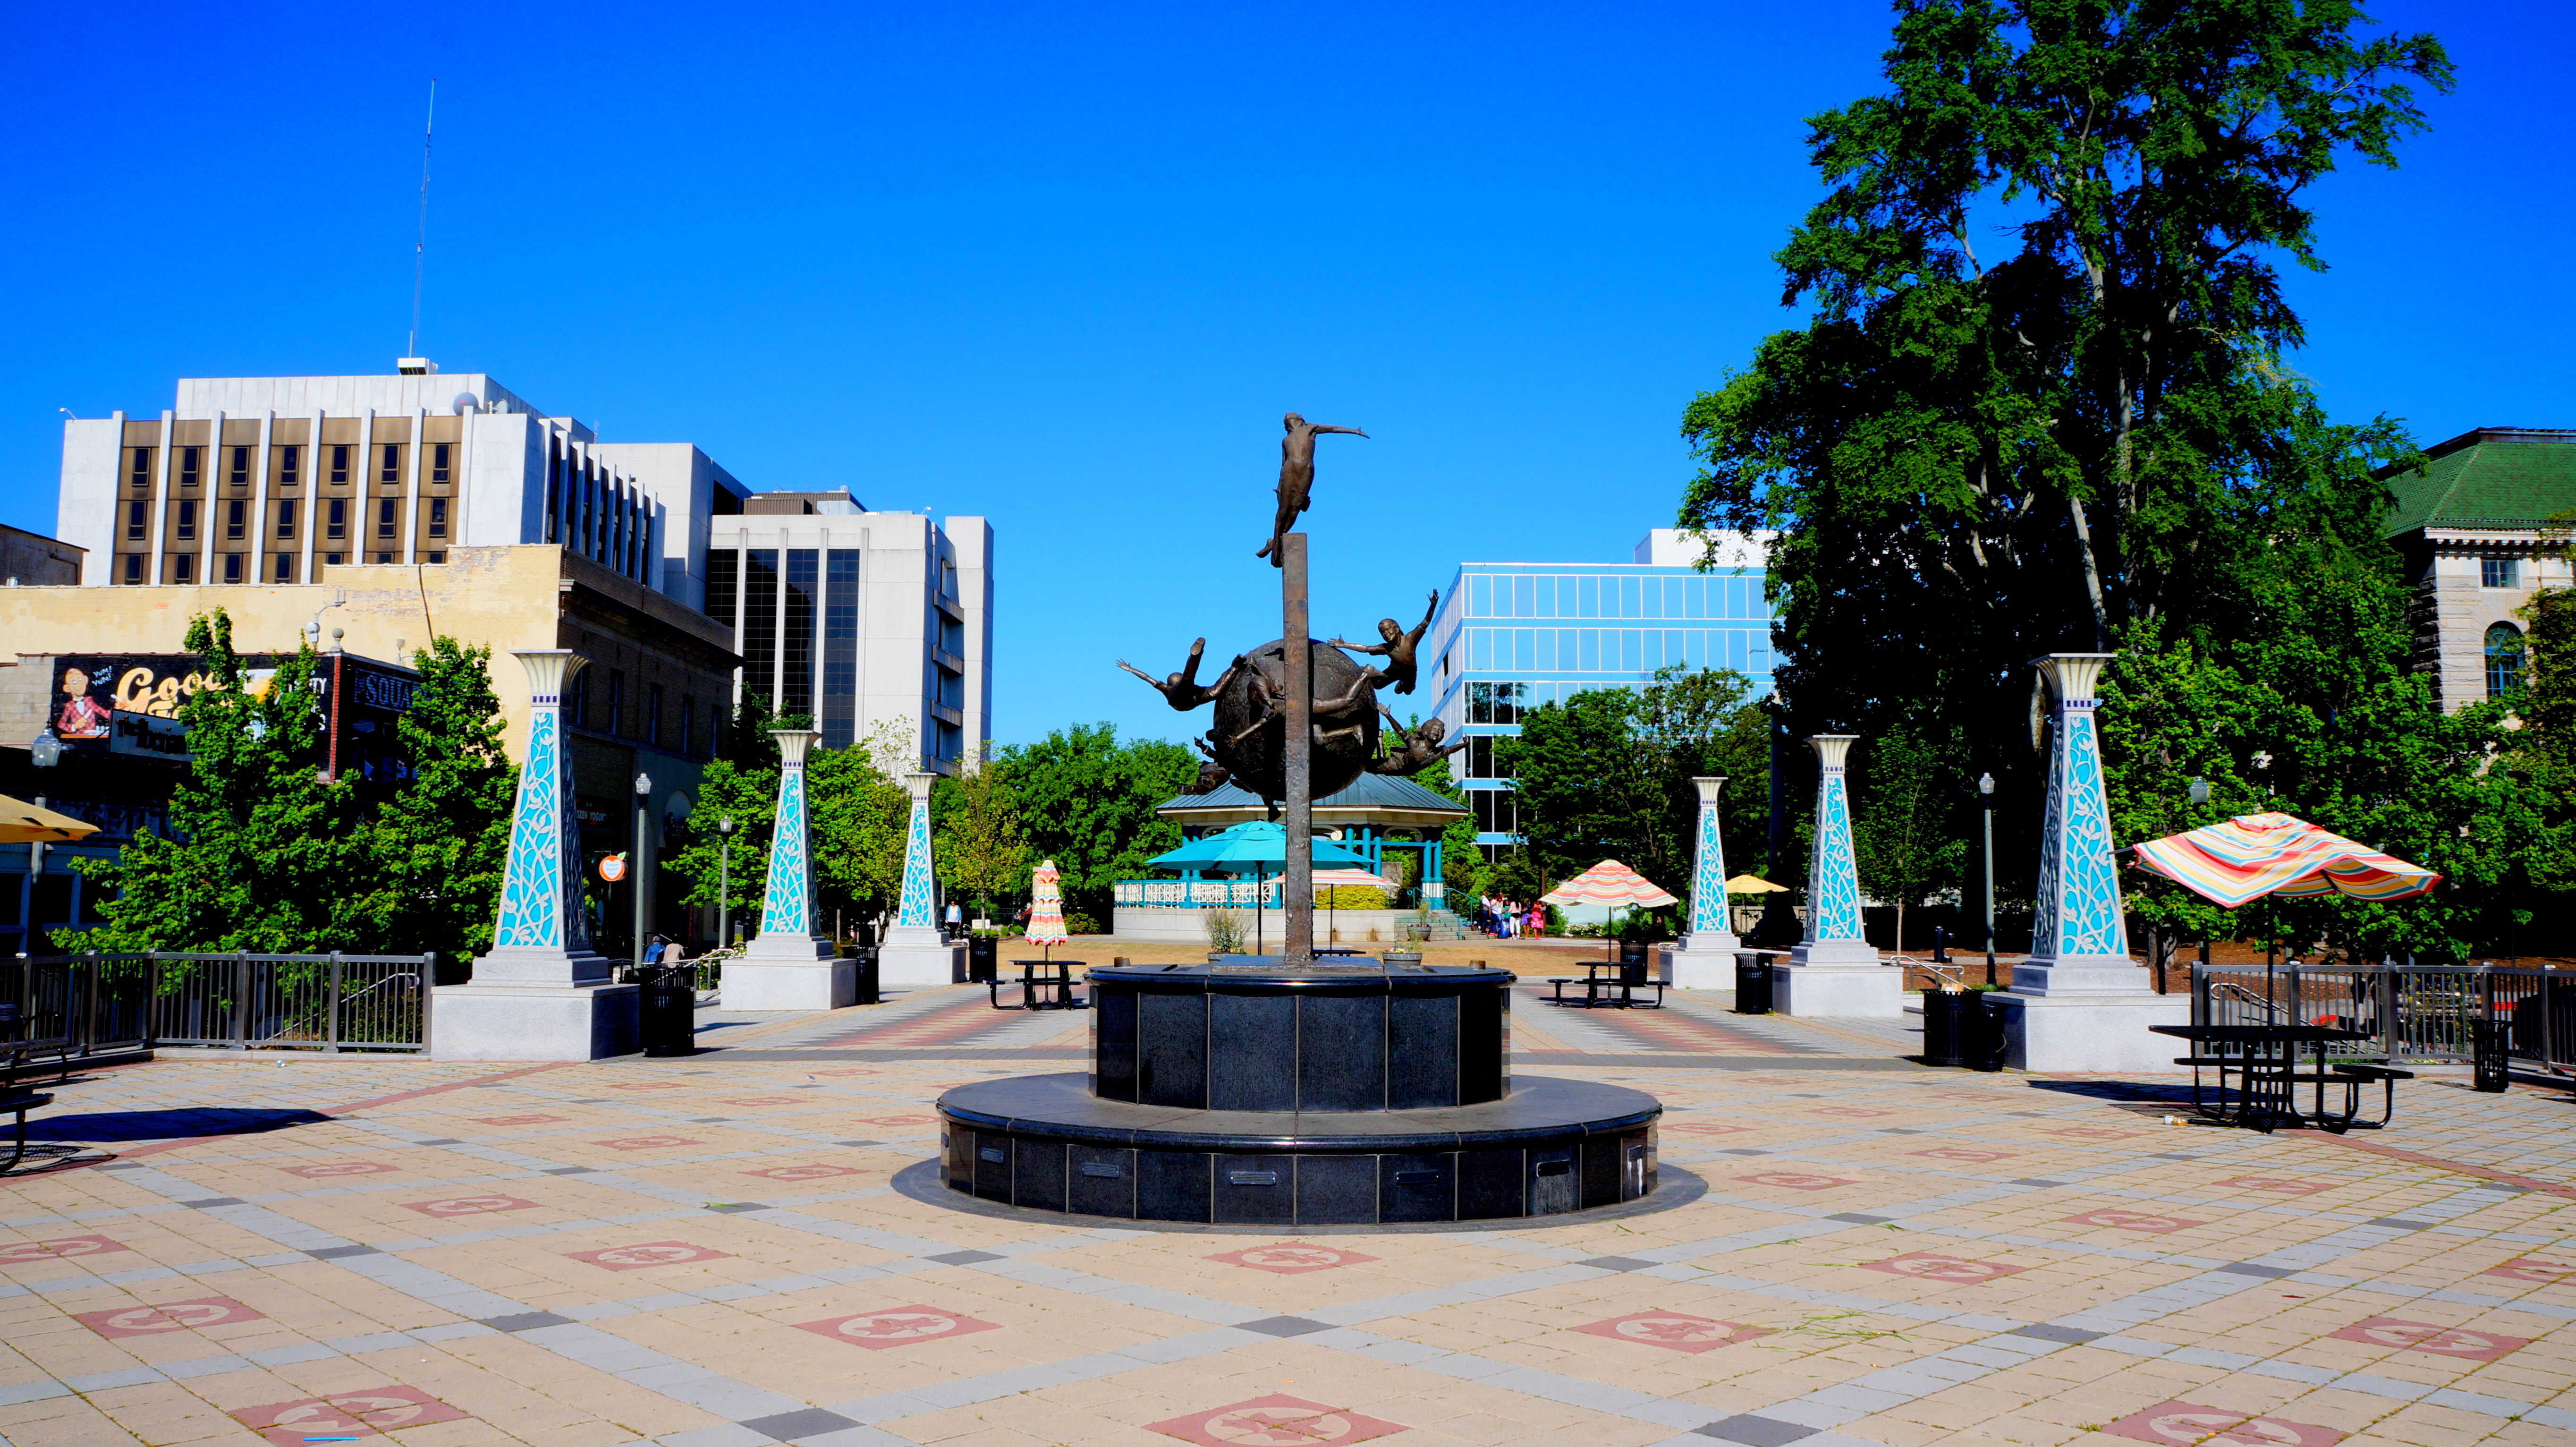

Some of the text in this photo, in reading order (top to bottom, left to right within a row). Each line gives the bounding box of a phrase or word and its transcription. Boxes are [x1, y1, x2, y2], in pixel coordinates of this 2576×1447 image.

[93, 665, 112, 678] YUM!
[91, 672, 112, 687] YUM!
[590, 811, 607, 822] YOGURT
